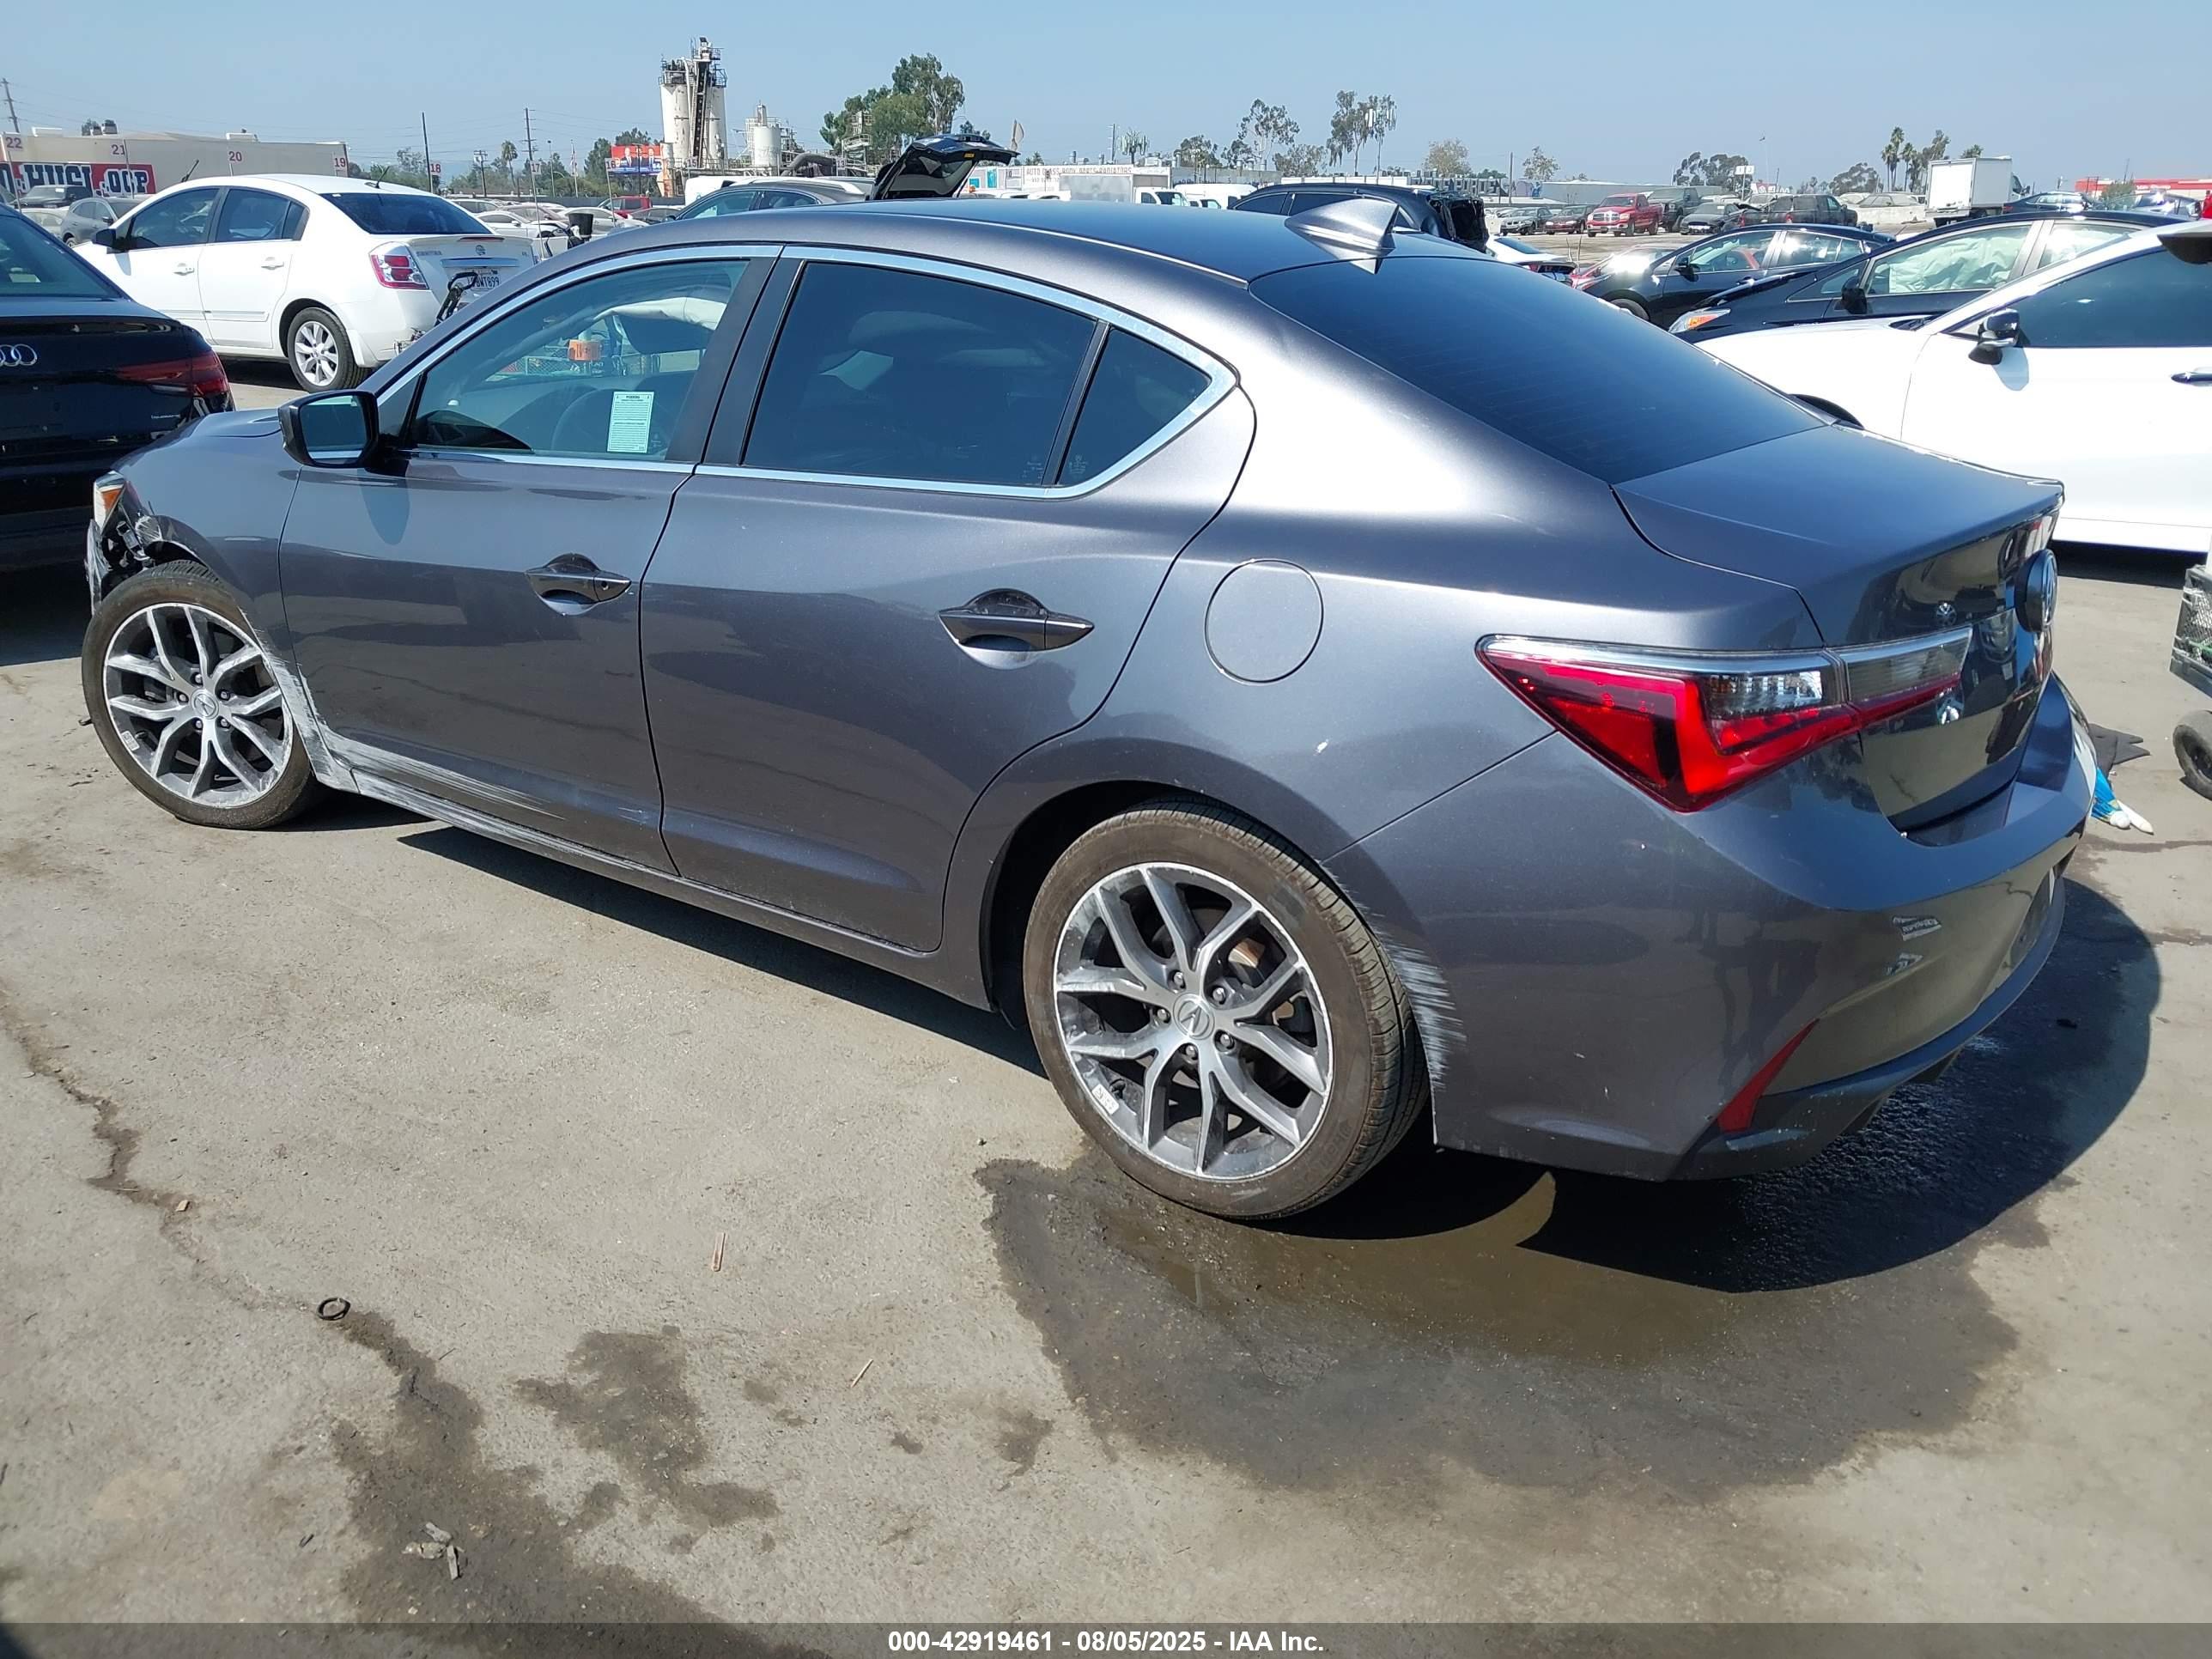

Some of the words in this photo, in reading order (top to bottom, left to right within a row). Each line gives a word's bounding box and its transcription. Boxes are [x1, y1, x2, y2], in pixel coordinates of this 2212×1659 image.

[6, 137, 22, 149] 22
[111, 144, 126, 155] 21
[228, 151, 242, 161] 20
[334, 157, 346, 167] 19
[606, 160, 616, 169] 16
[688, 157, 697, 167] 15
[430, 163, 441, 173] 18
[532, 163, 541, 173] 17
[1026, 167, 1041, 176] AUTO
